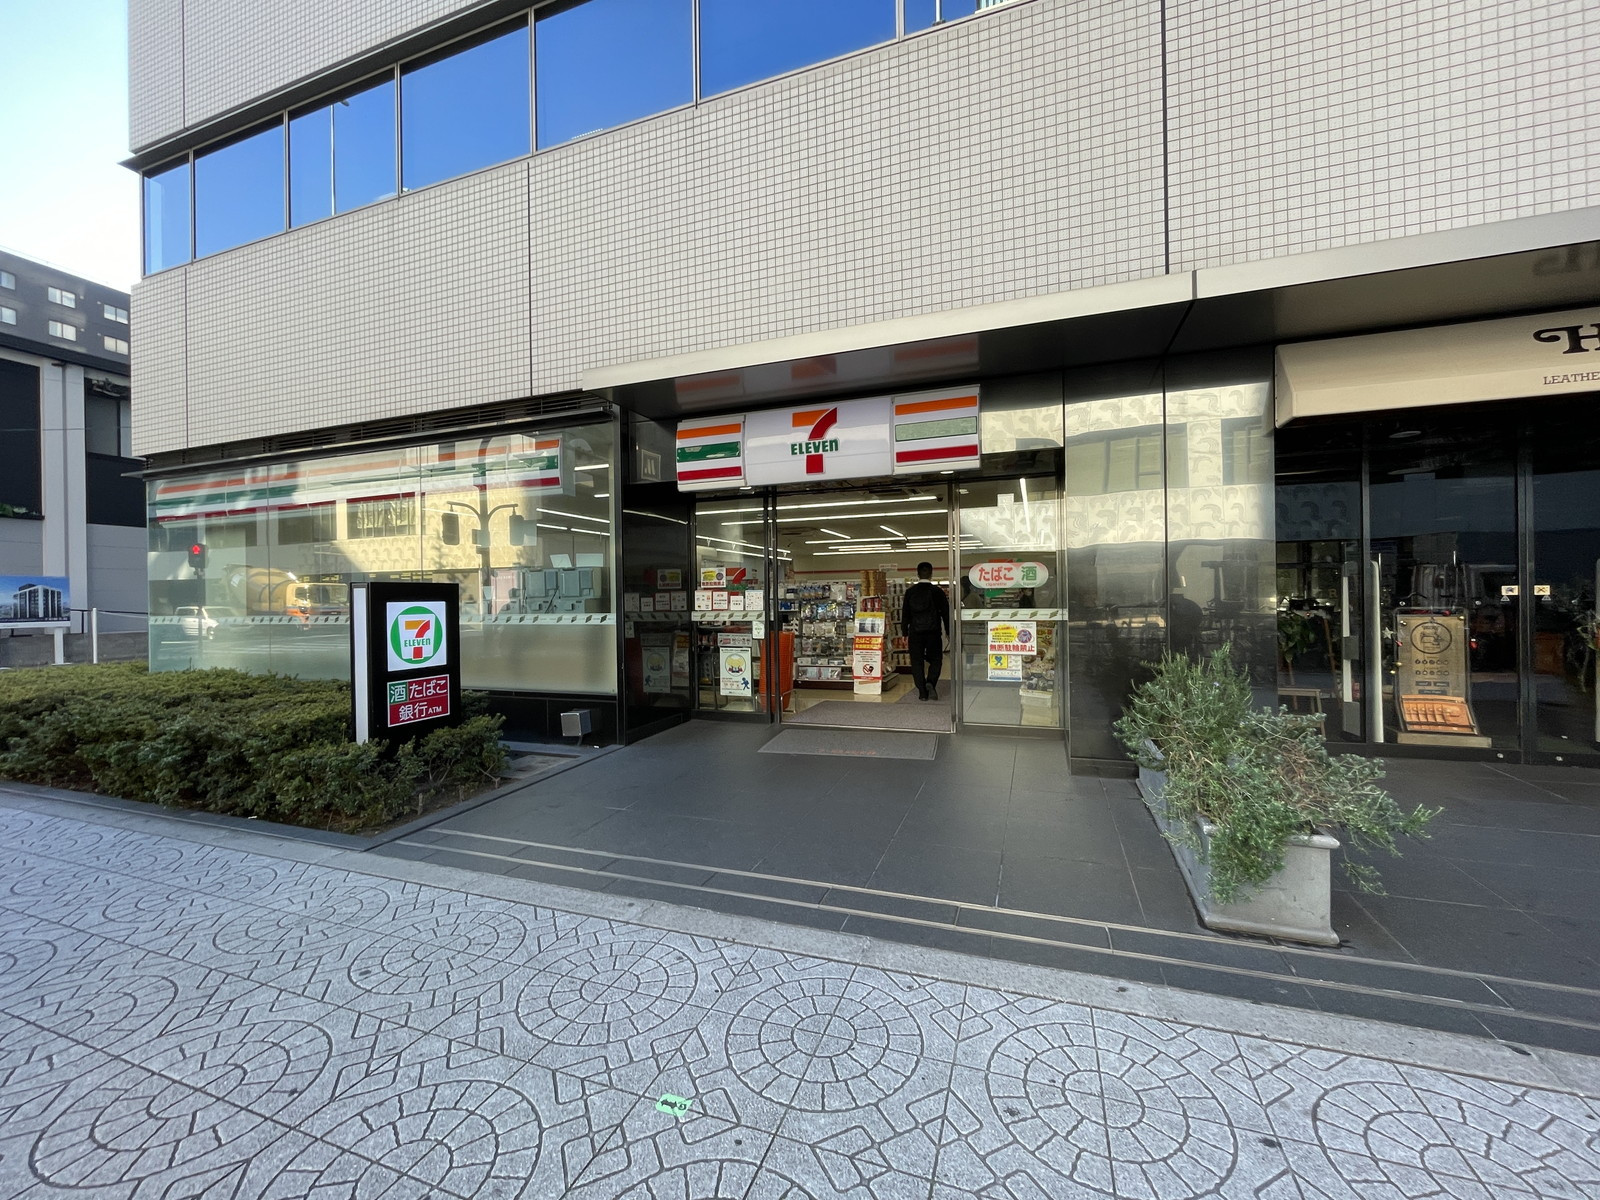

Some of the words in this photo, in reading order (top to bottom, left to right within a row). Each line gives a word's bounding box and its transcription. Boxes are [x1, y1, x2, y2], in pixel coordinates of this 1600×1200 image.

[978, 565, 1015, 582] たばこ
[1021, 565, 1038, 581] 酒
[390, 685, 406, 703] 酒
[409, 680, 447, 699] たばこ
[399, 702, 428, 721] 銀行
[428, 706, 442, 714] ATM
